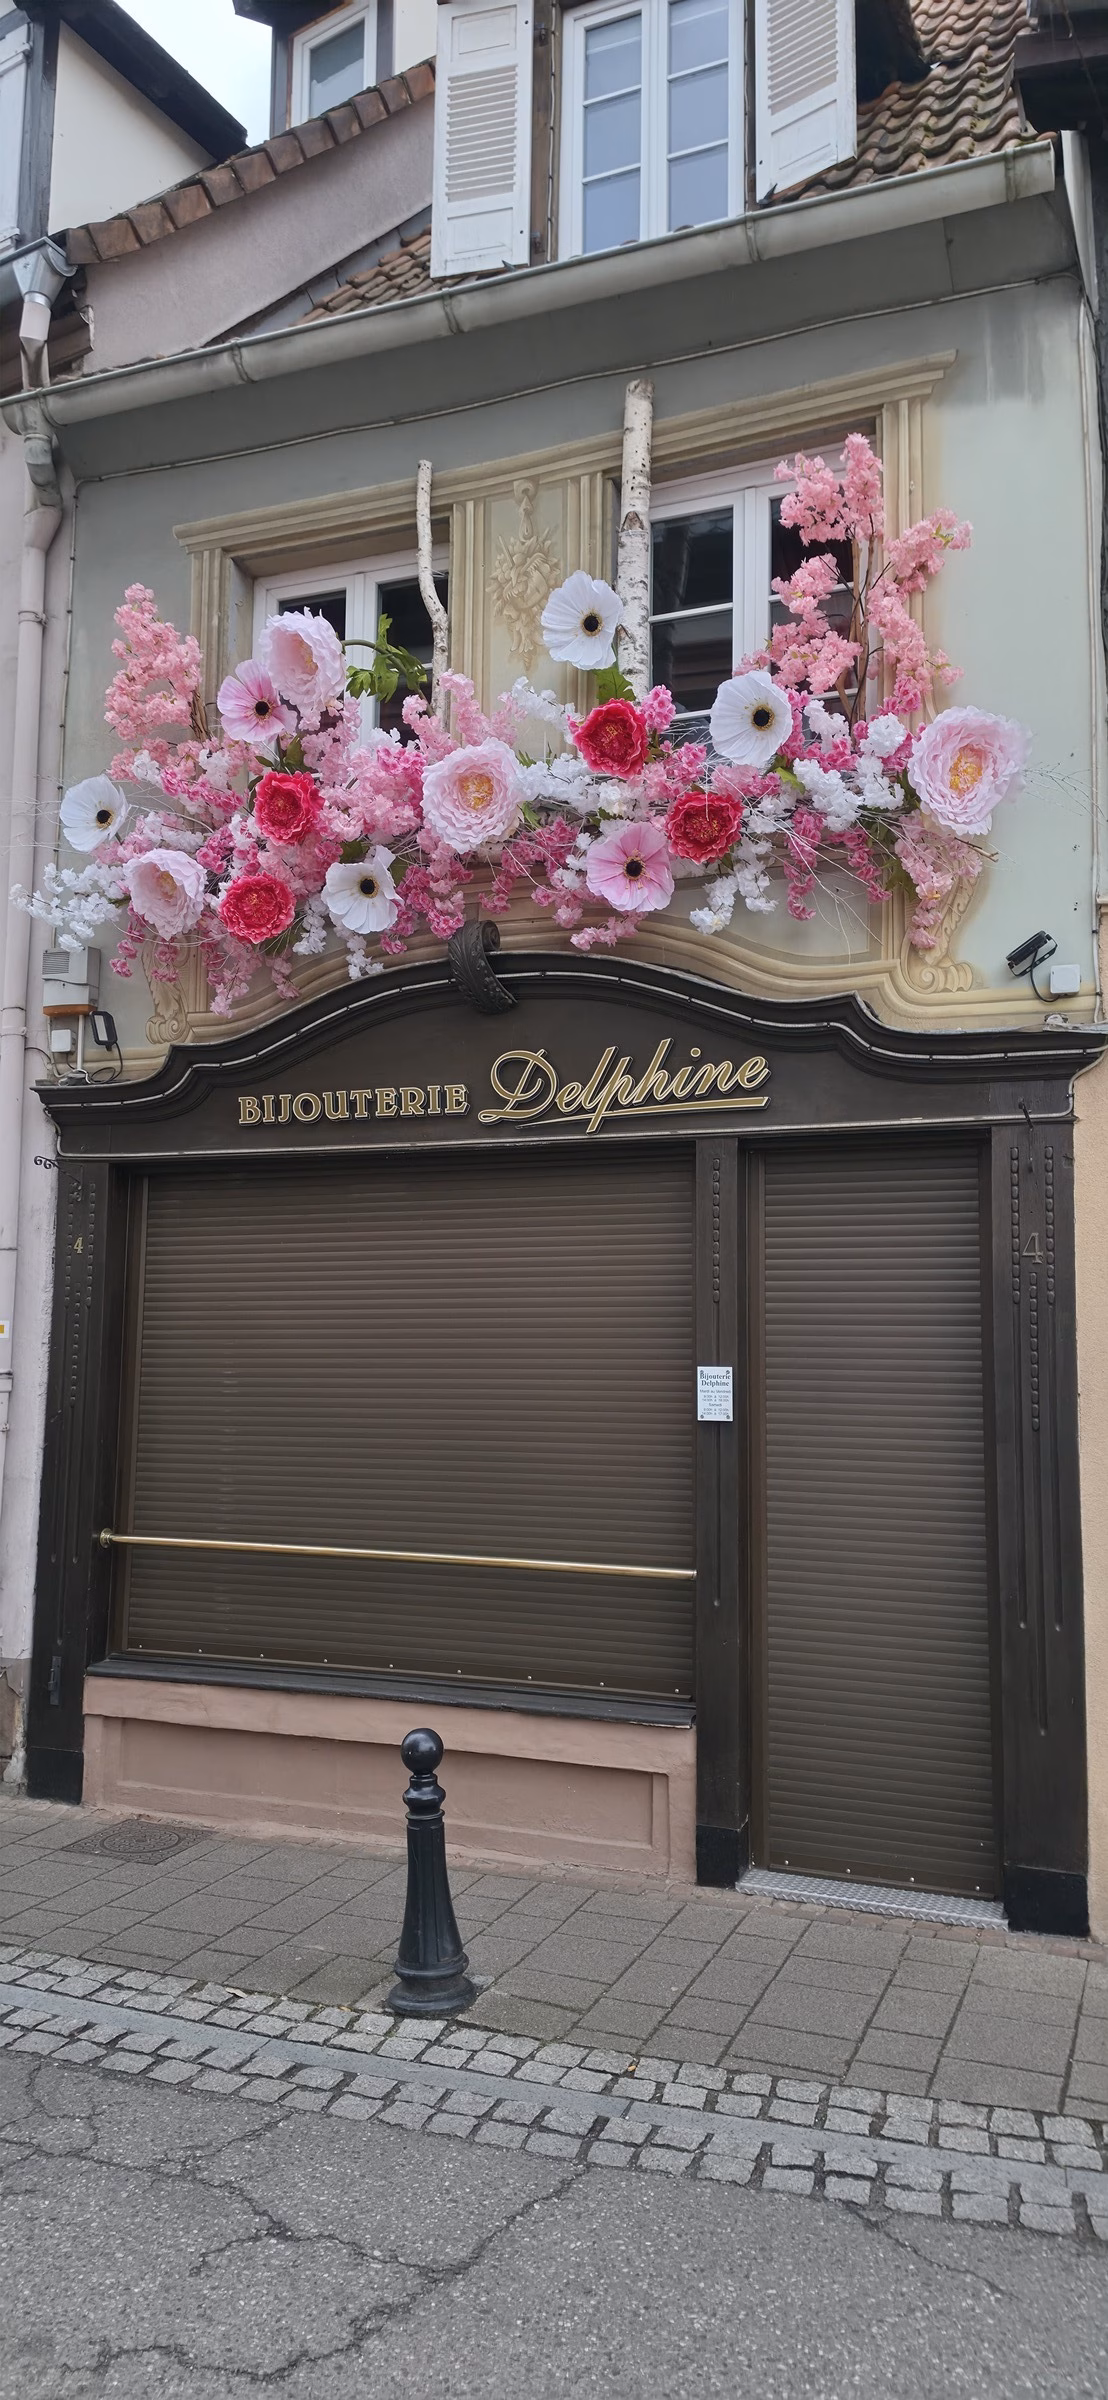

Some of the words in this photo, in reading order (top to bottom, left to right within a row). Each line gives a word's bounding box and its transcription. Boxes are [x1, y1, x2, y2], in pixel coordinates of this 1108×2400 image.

[237, 1082, 469, 1126] BIJOUTERIE
[477, 1038, 772, 1135] Delphine
[73, 1236, 84, 1254] 4
[1021, 1232, 1044, 1265] 4
